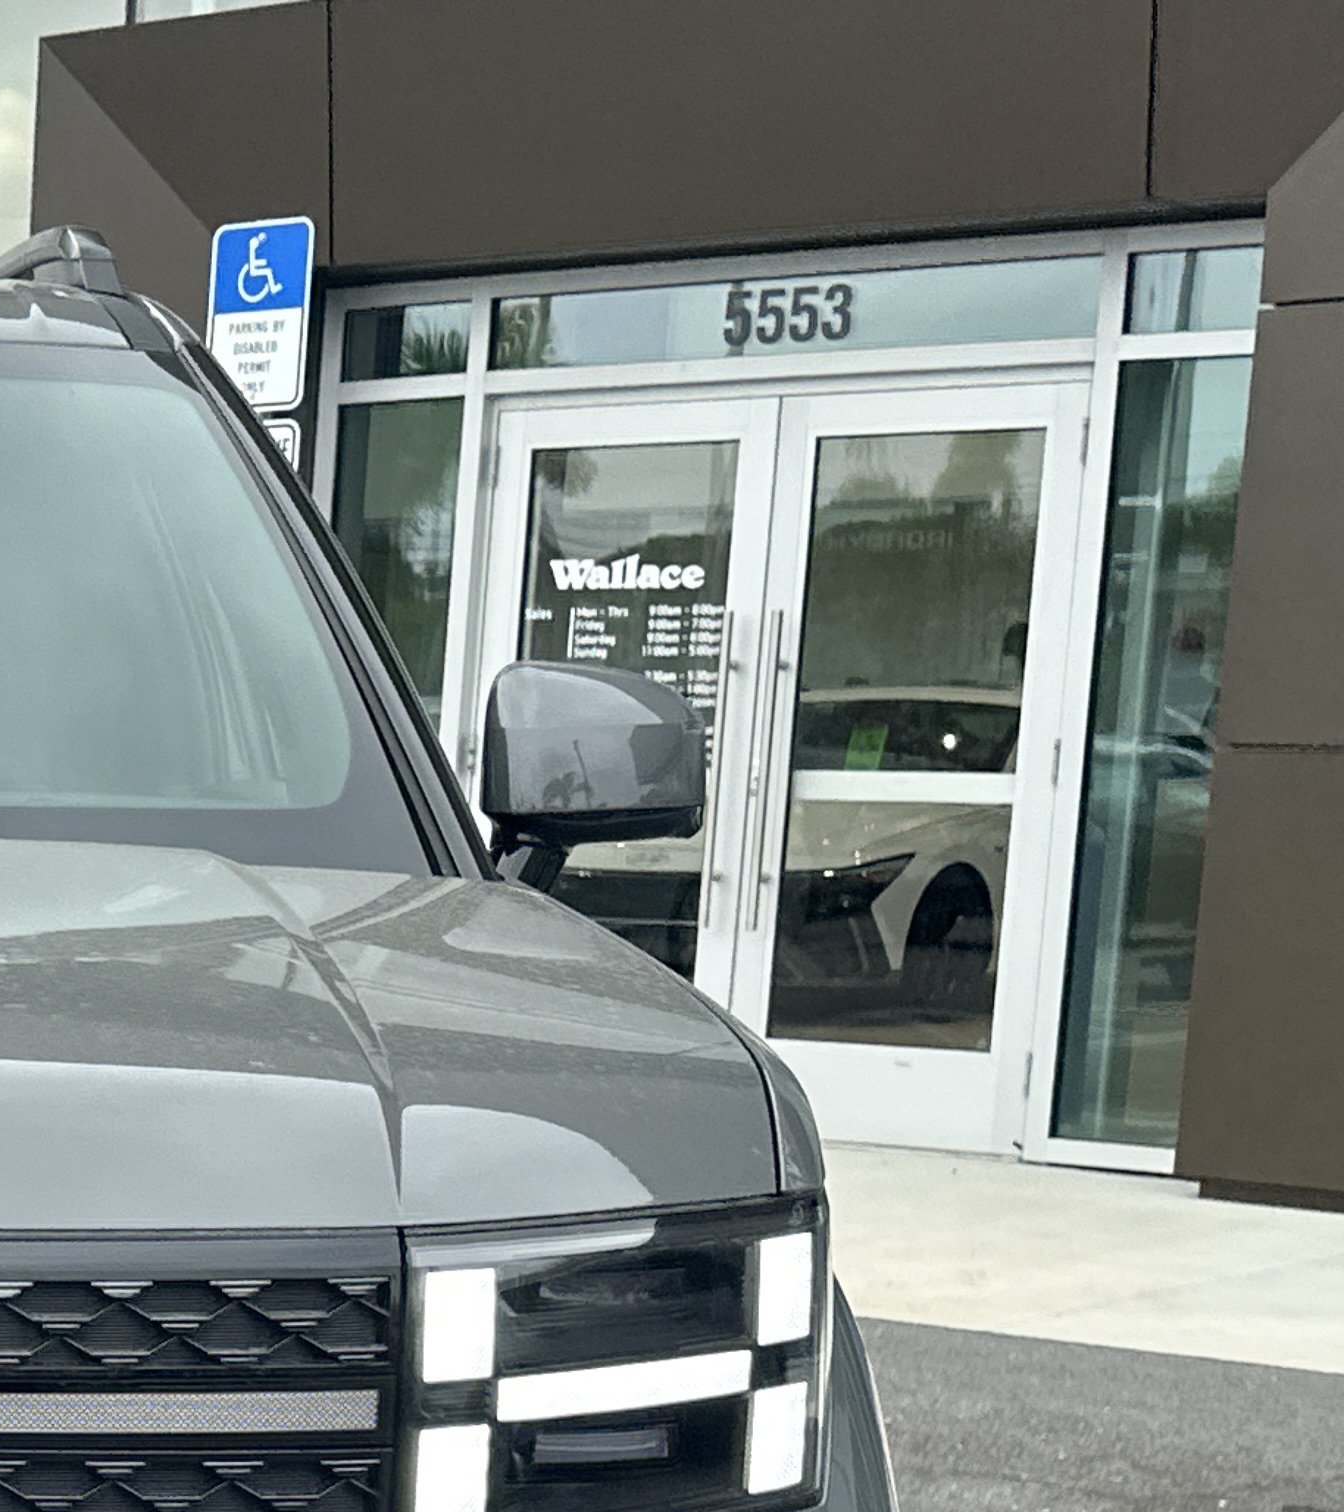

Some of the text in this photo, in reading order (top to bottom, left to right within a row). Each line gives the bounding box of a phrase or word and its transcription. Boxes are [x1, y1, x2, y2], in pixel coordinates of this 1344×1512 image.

[723, 284, 853, 347] 5553
[228, 319, 285, 335] PARKING BY
[233, 340, 278, 356] DISABLED
[237, 359, 271, 374] PERMIT
[549, 553, 705, 590] Wallace
